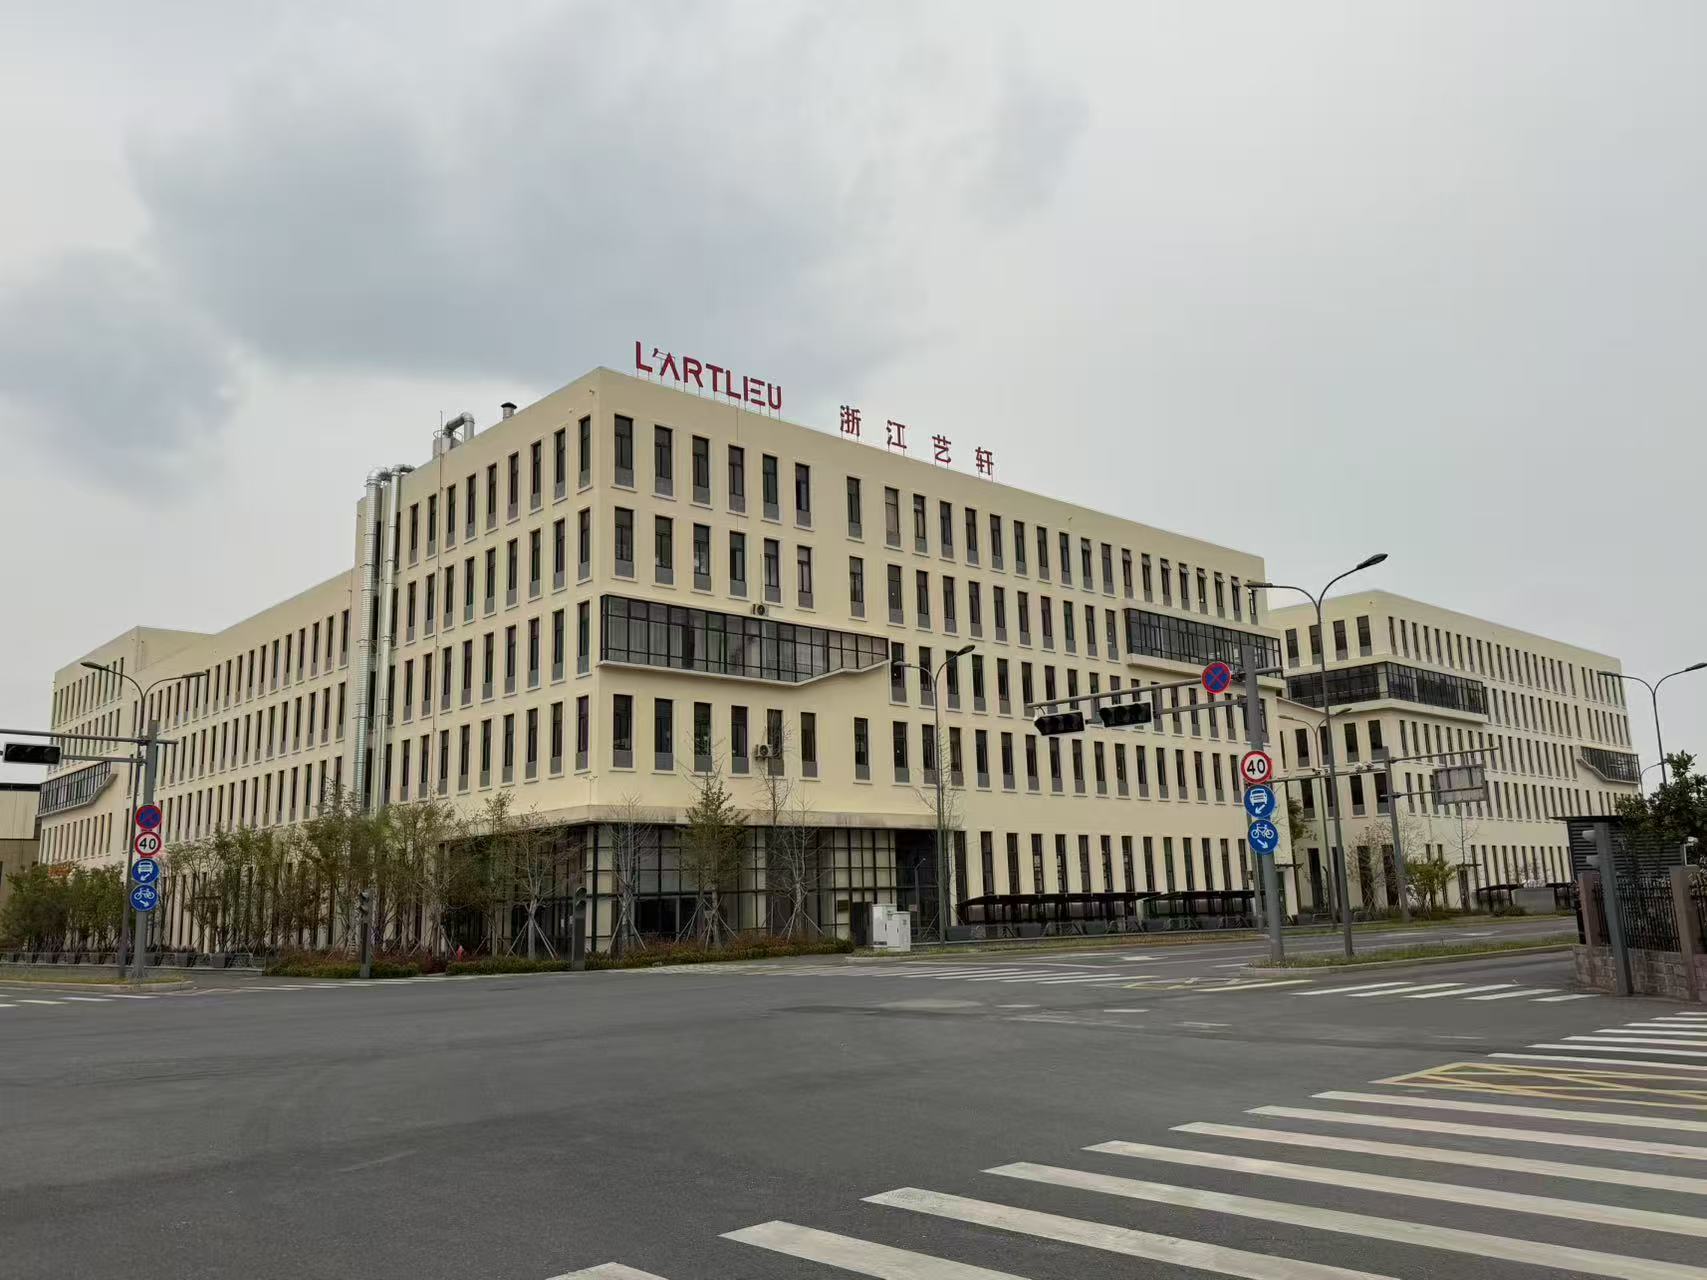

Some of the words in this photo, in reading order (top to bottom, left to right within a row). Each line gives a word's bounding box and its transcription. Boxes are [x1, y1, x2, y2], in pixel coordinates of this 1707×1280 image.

[840, 405, 994, 476] 浙江艺轩
[1246, 758, 1266, 775] 40
[139, 837, 157, 850] 40
